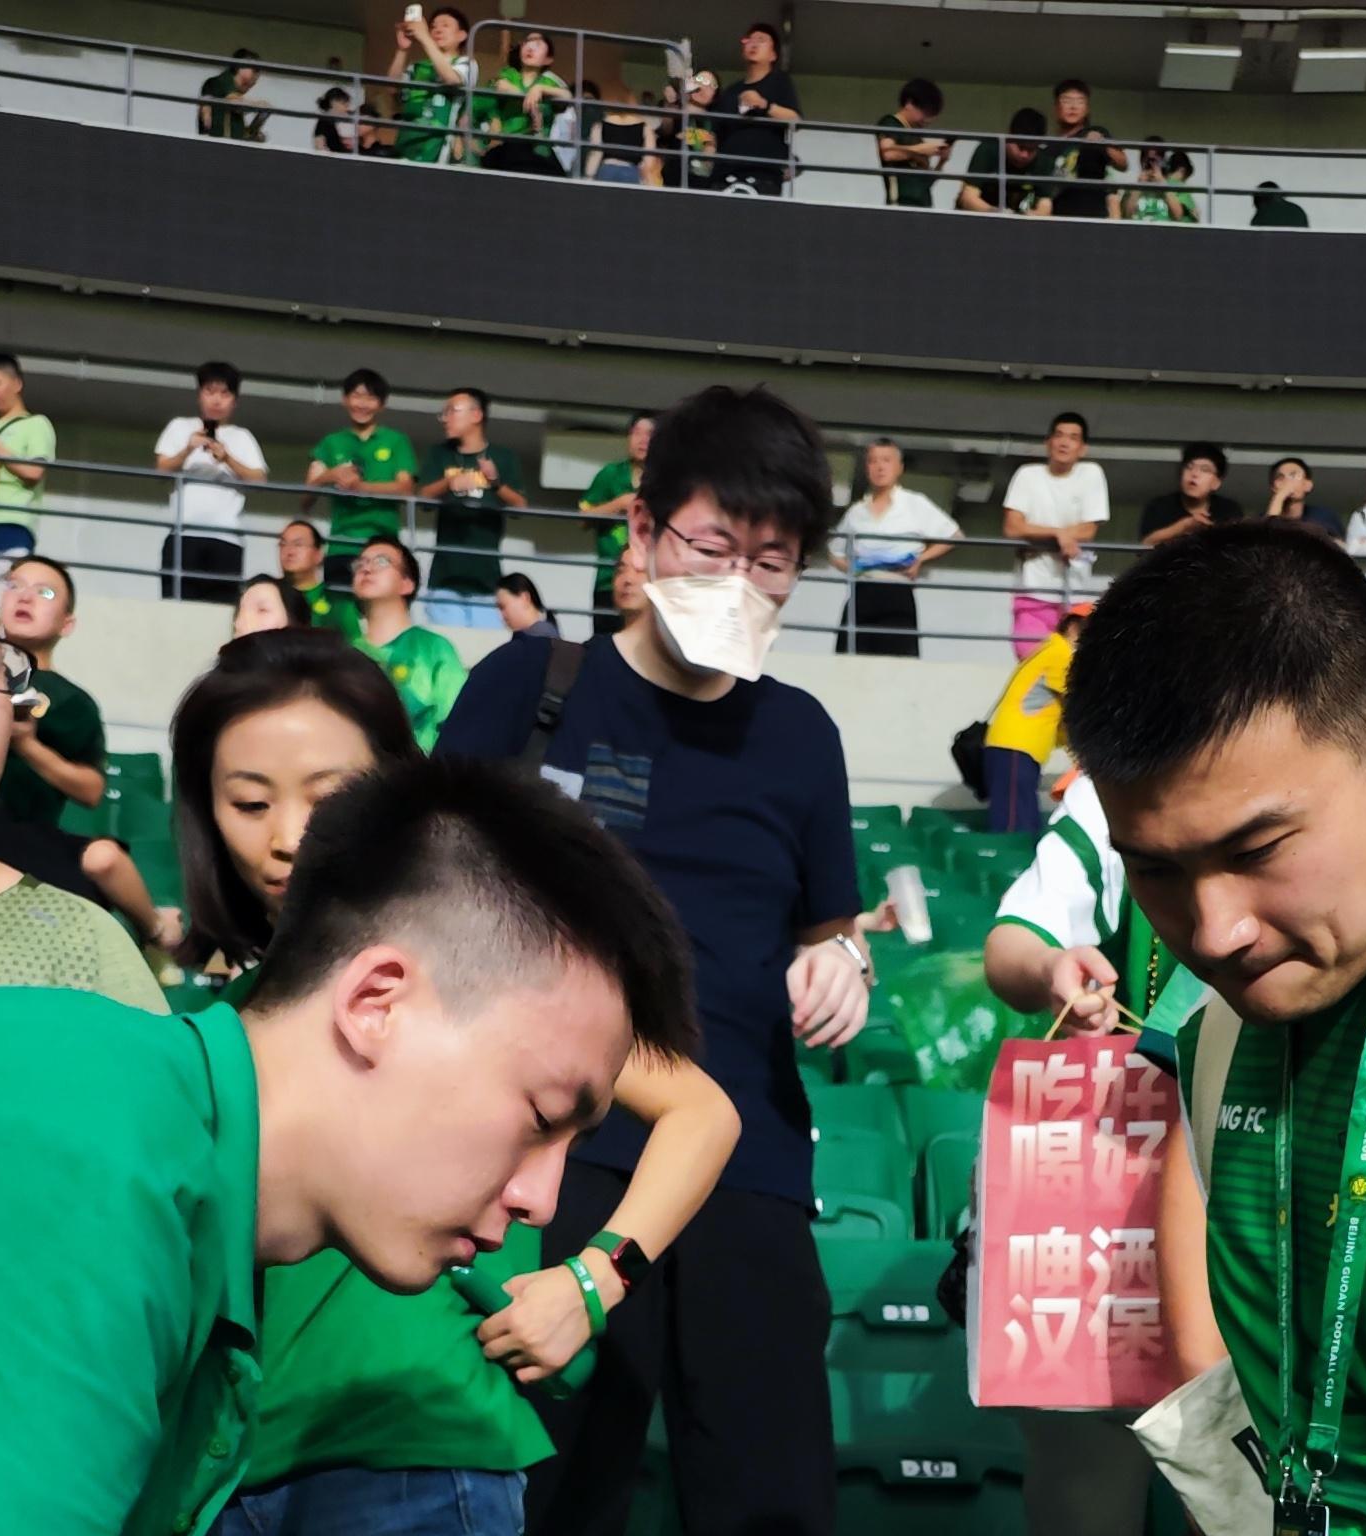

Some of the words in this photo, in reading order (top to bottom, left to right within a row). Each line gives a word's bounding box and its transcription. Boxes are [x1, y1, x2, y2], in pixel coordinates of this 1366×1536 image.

[1013, 1050, 1166, 1120] 吃好
[1010, 1117, 1166, 1201] 喝好
[1009, 1225, 1156, 1297] 啤酒
[1343, 1216, 1360, 1263] BEIJING
[1336, 1266, 1352, 1311] GUOAN
[1328, 1314, 1345, 1375] FOOTBALL
[1324, 1377, 1336, 1408] CLUB
